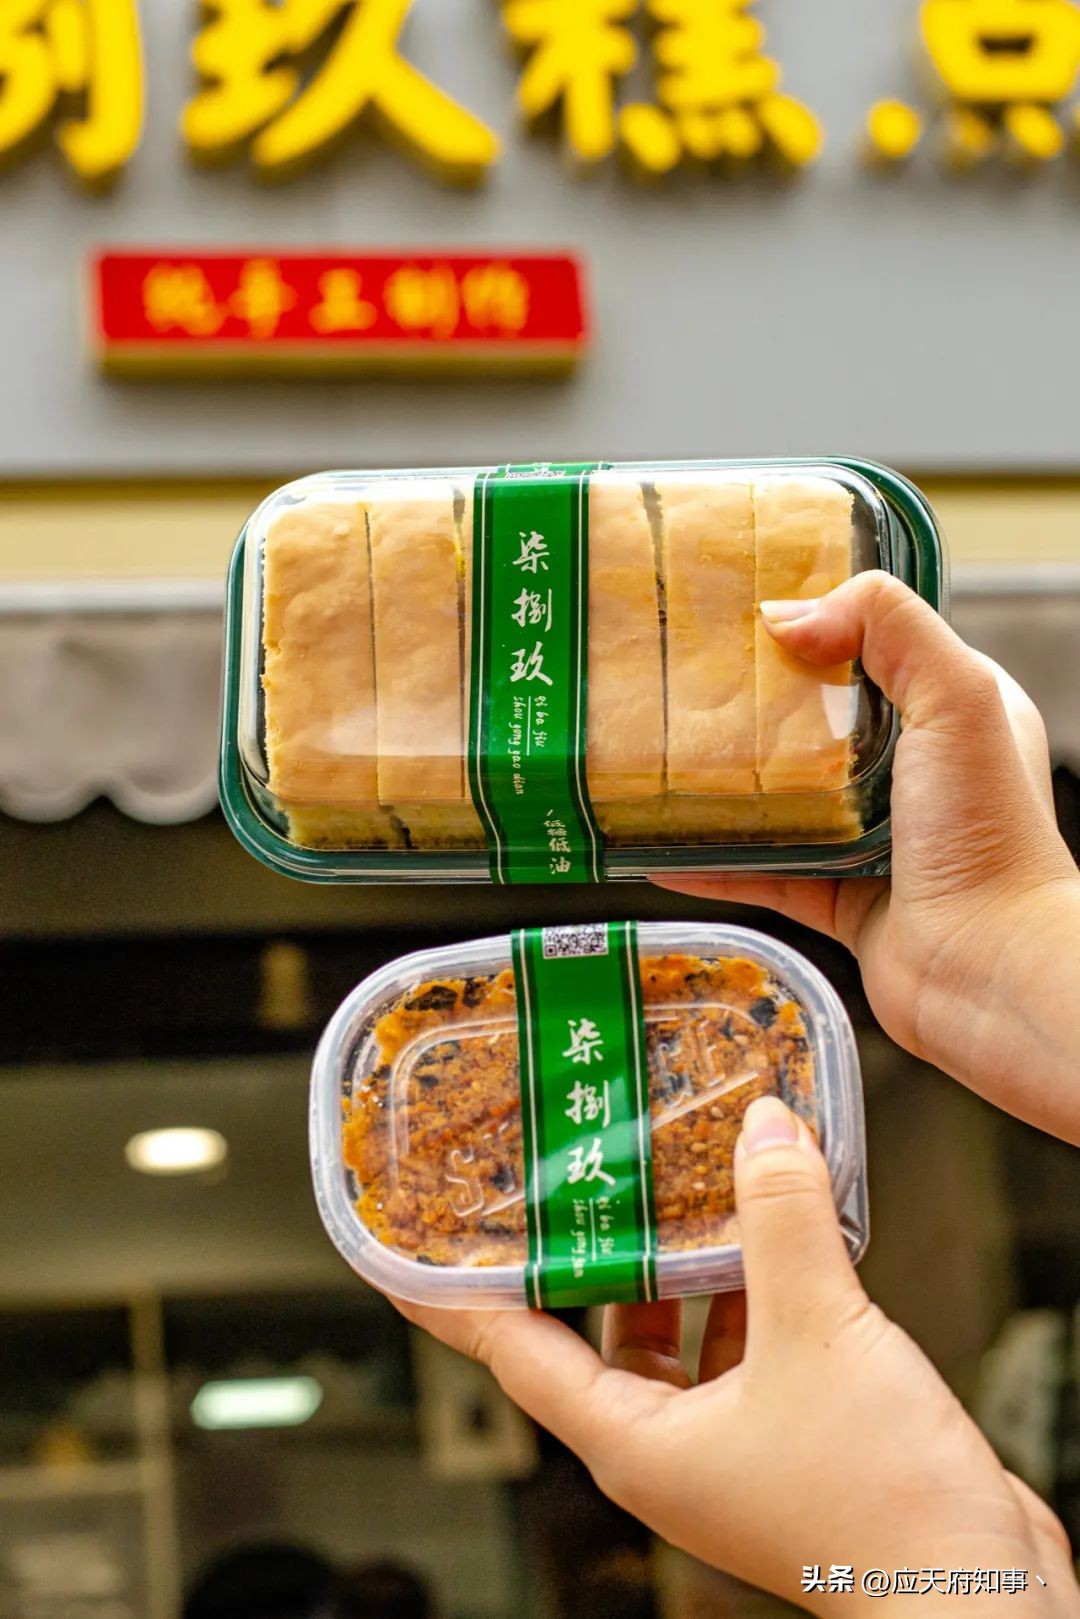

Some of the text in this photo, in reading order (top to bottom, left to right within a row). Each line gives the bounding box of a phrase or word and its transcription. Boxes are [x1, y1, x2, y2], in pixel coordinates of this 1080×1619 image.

[510, 530, 553, 685] 柒捌玖
[562, 1018, 617, 1186] 柒捌玖
